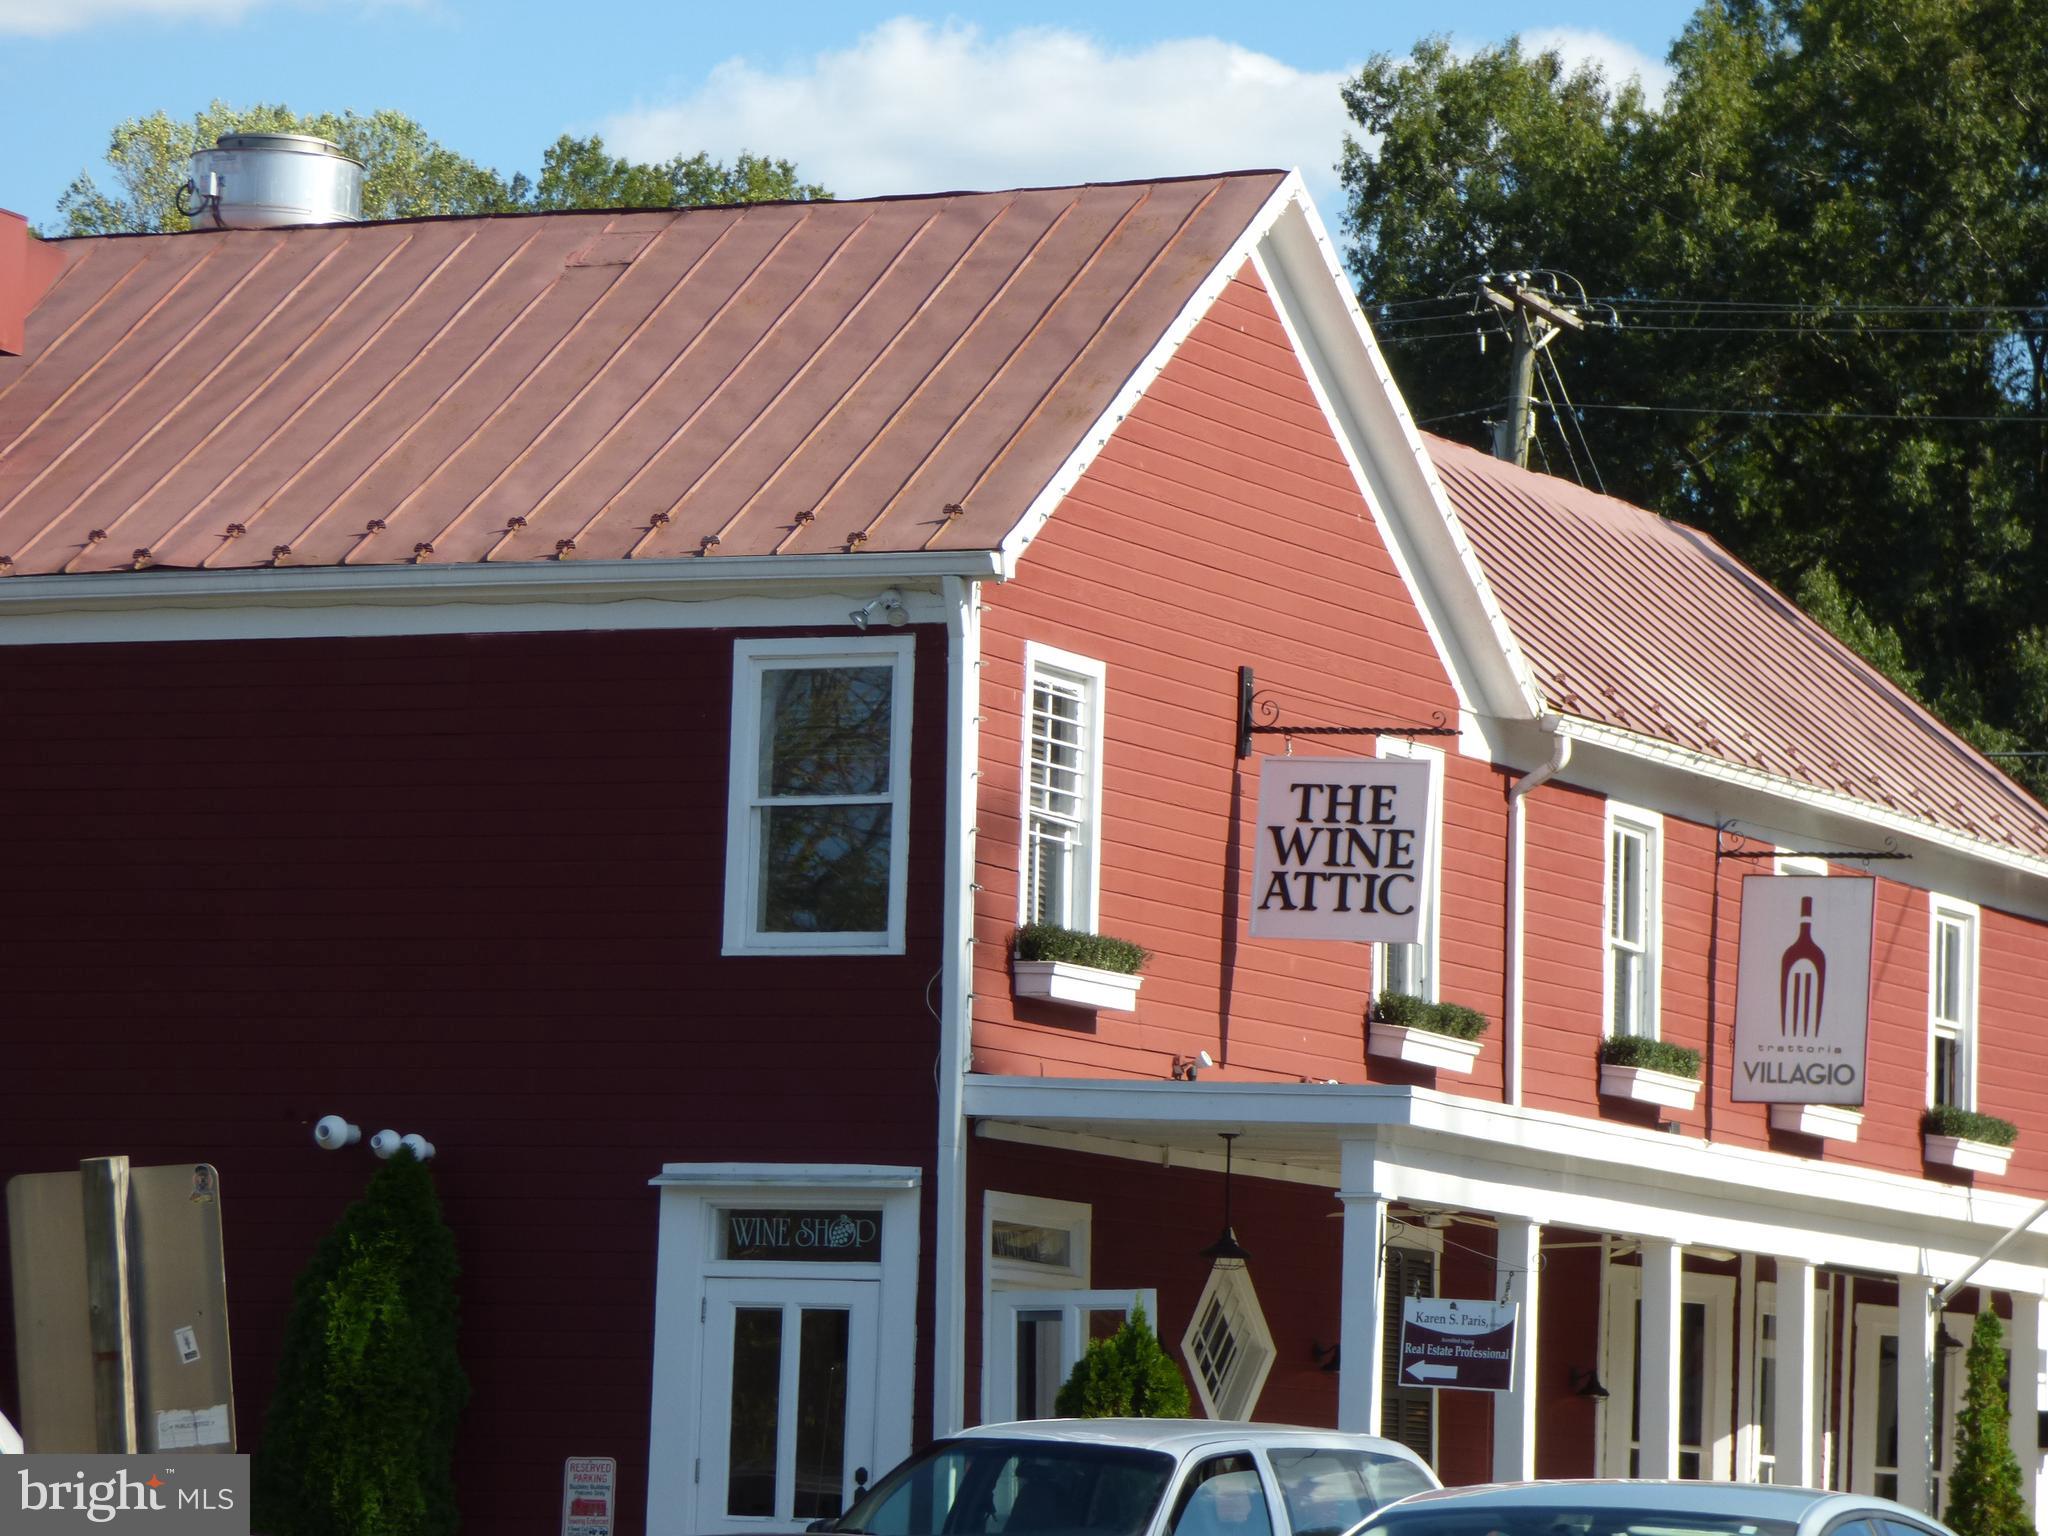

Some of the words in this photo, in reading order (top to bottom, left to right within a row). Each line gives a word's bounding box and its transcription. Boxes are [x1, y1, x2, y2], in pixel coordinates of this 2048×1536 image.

[1290, 783, 1397, 825] THE
[1267, 825, 1415, 869] WINE
[1257, 871, 1415, 915] ATTIC
[1758, 1044, 1842, 1054] trattoria
[1743, 1061, 1855, 1086] VILLAGIO
[732, 1217, 791, 1247] WINE
[795, 1215, 876, 1247] SHOP
[1415, 1311, 1446, 1324] Karen
[1449, 1313, 1458, 1325] S.
[1461, 1314, 1488, 1328] Paris,
[1405, 1343, 1425, 1354] Real
[1427, 1344, 1452, 1356] Estate
[1455, 1345, 1509, 1360] Professional
[570, 1463, 612, 1472] RESERVED
[573, 1473, 608, 1483] PARKING
